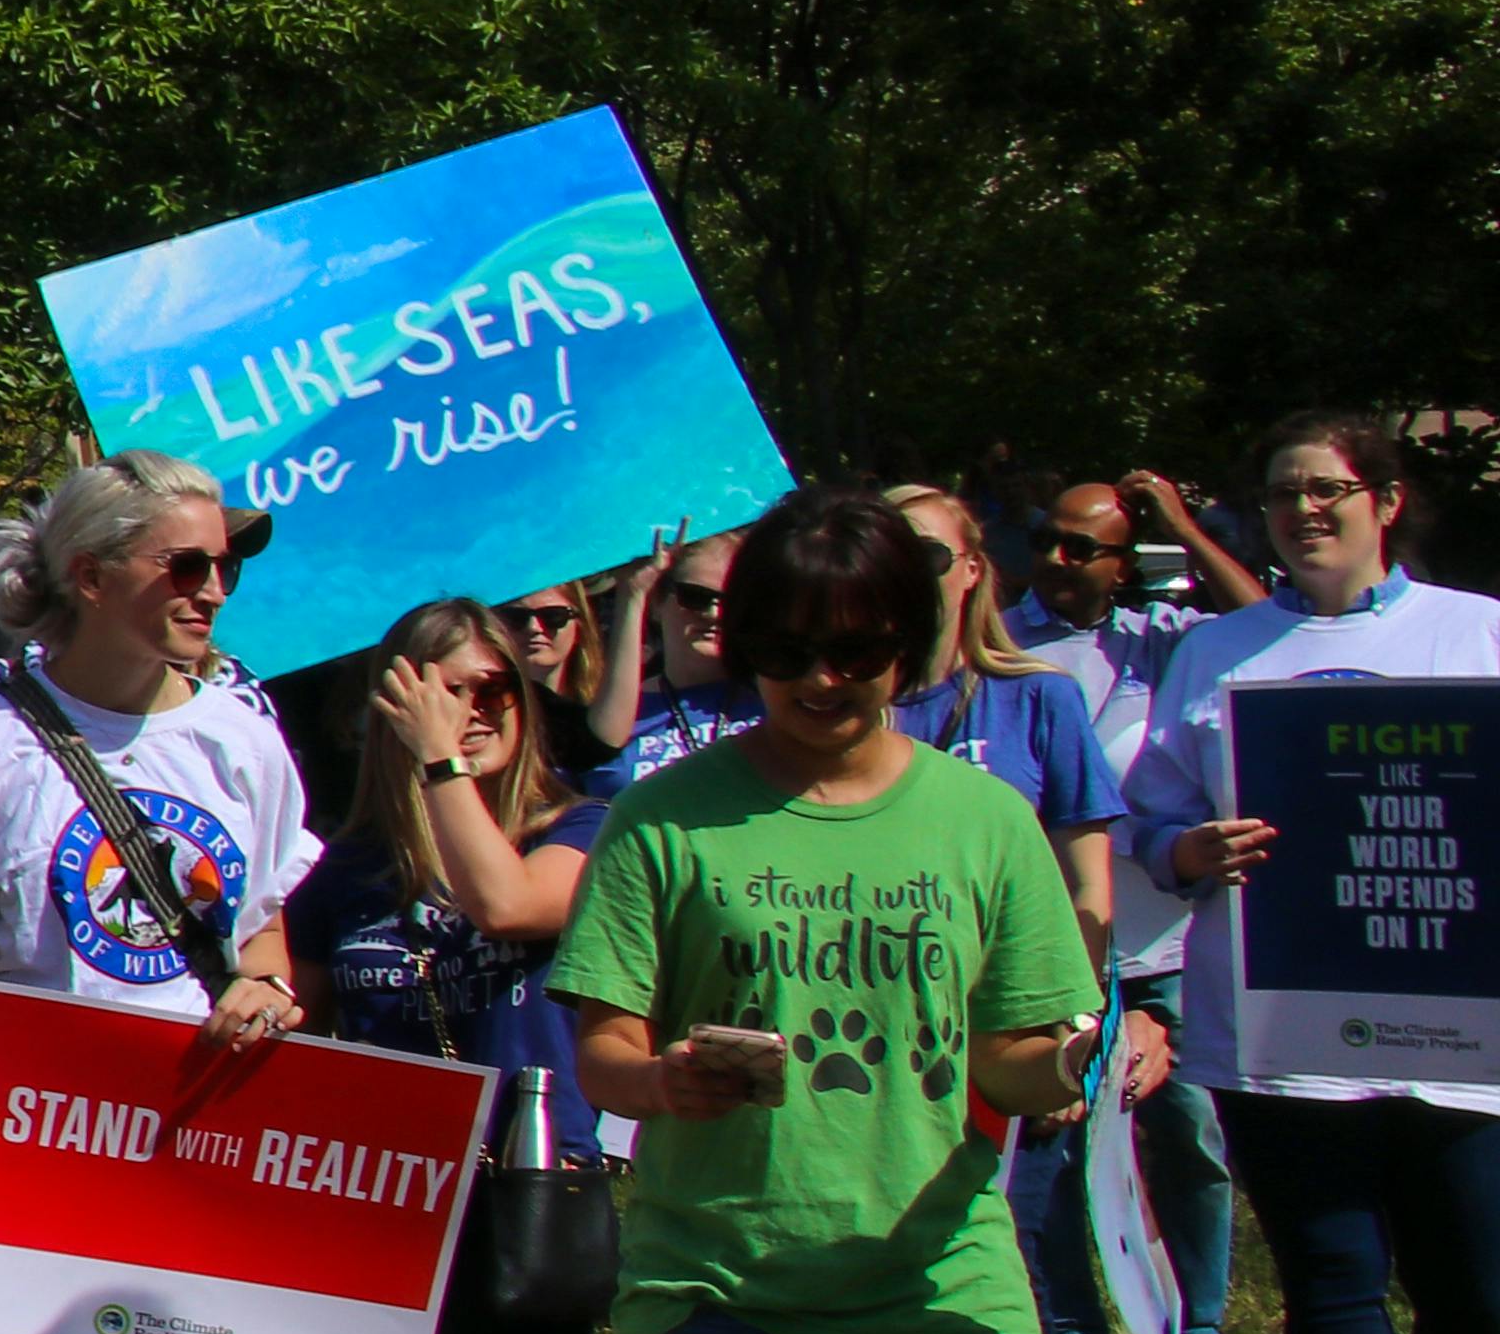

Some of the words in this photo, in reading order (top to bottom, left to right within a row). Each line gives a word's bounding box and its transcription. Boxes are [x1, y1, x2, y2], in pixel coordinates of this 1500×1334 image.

[188, 324, 384, 441] LIKE
[393, 253, 653, 375] SEAS,
[245, 445, 356, 509] we
[385, 345, 578, 472] rise!
[1327, 724, 1471, 755] FIGHT
[1379, 763, 1422, 787] LIKE
[1359, 795, 1445, 829] YOUR
[1349, 835, 1459, 869] WORLD
[712, 876, 729, 908] i
[746, 865, 855, 915] stand
[873, 870, 952, 922] with
[1335, 874, 1476, 911] DEPENDS
[73, 919, 113, 959] OF
[1366, 915, 1407, 949] ON
[1419, 916, 1447, 950] IT
[720, 912, 944, 995] wildlife
[2, 1085, 162, 1164] STAND
[175, 1126, 244, 1167] WITH
[252, 1128, 455, 1213] REALITY
[135, 1312, 167, 1329] The
